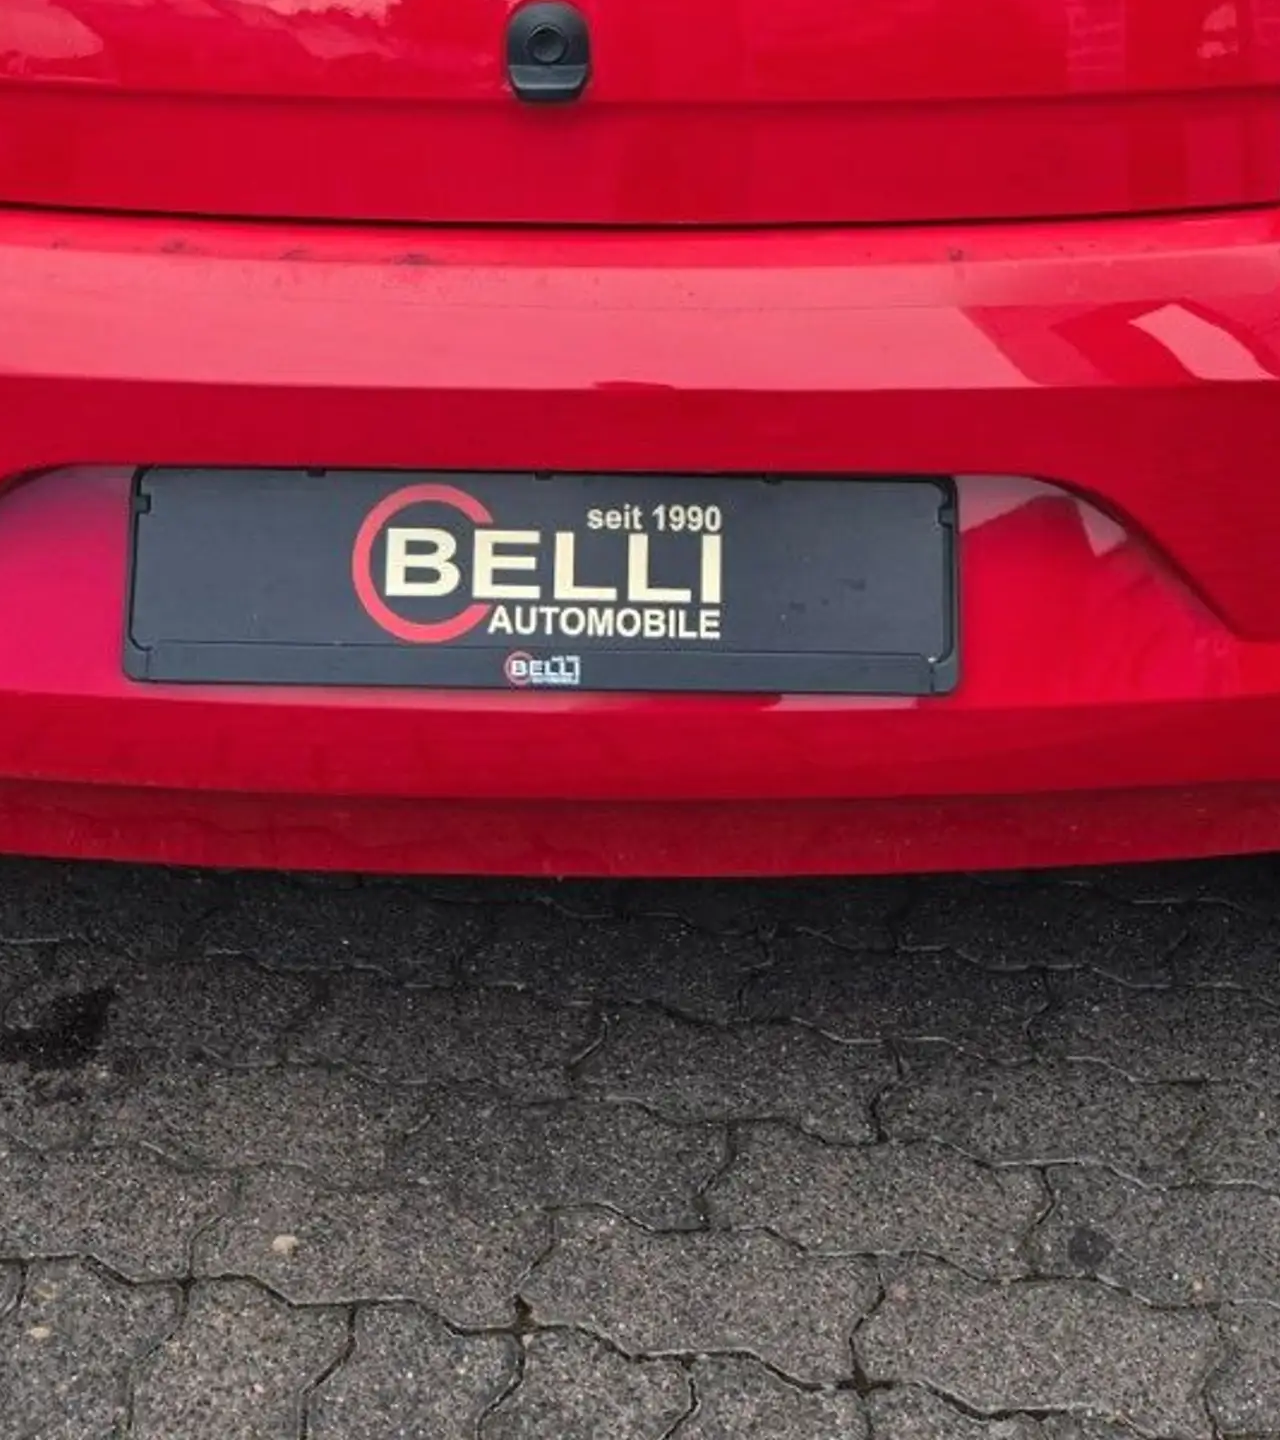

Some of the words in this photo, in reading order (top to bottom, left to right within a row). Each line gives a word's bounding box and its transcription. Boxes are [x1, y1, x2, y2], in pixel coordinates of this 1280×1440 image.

[587, 504, 643, 531] seit
[652, 505, 722, 532] 1990
[385, 528, 721, 604] BELLI
[488, 606, 721, 639] AUTOMOBILE
